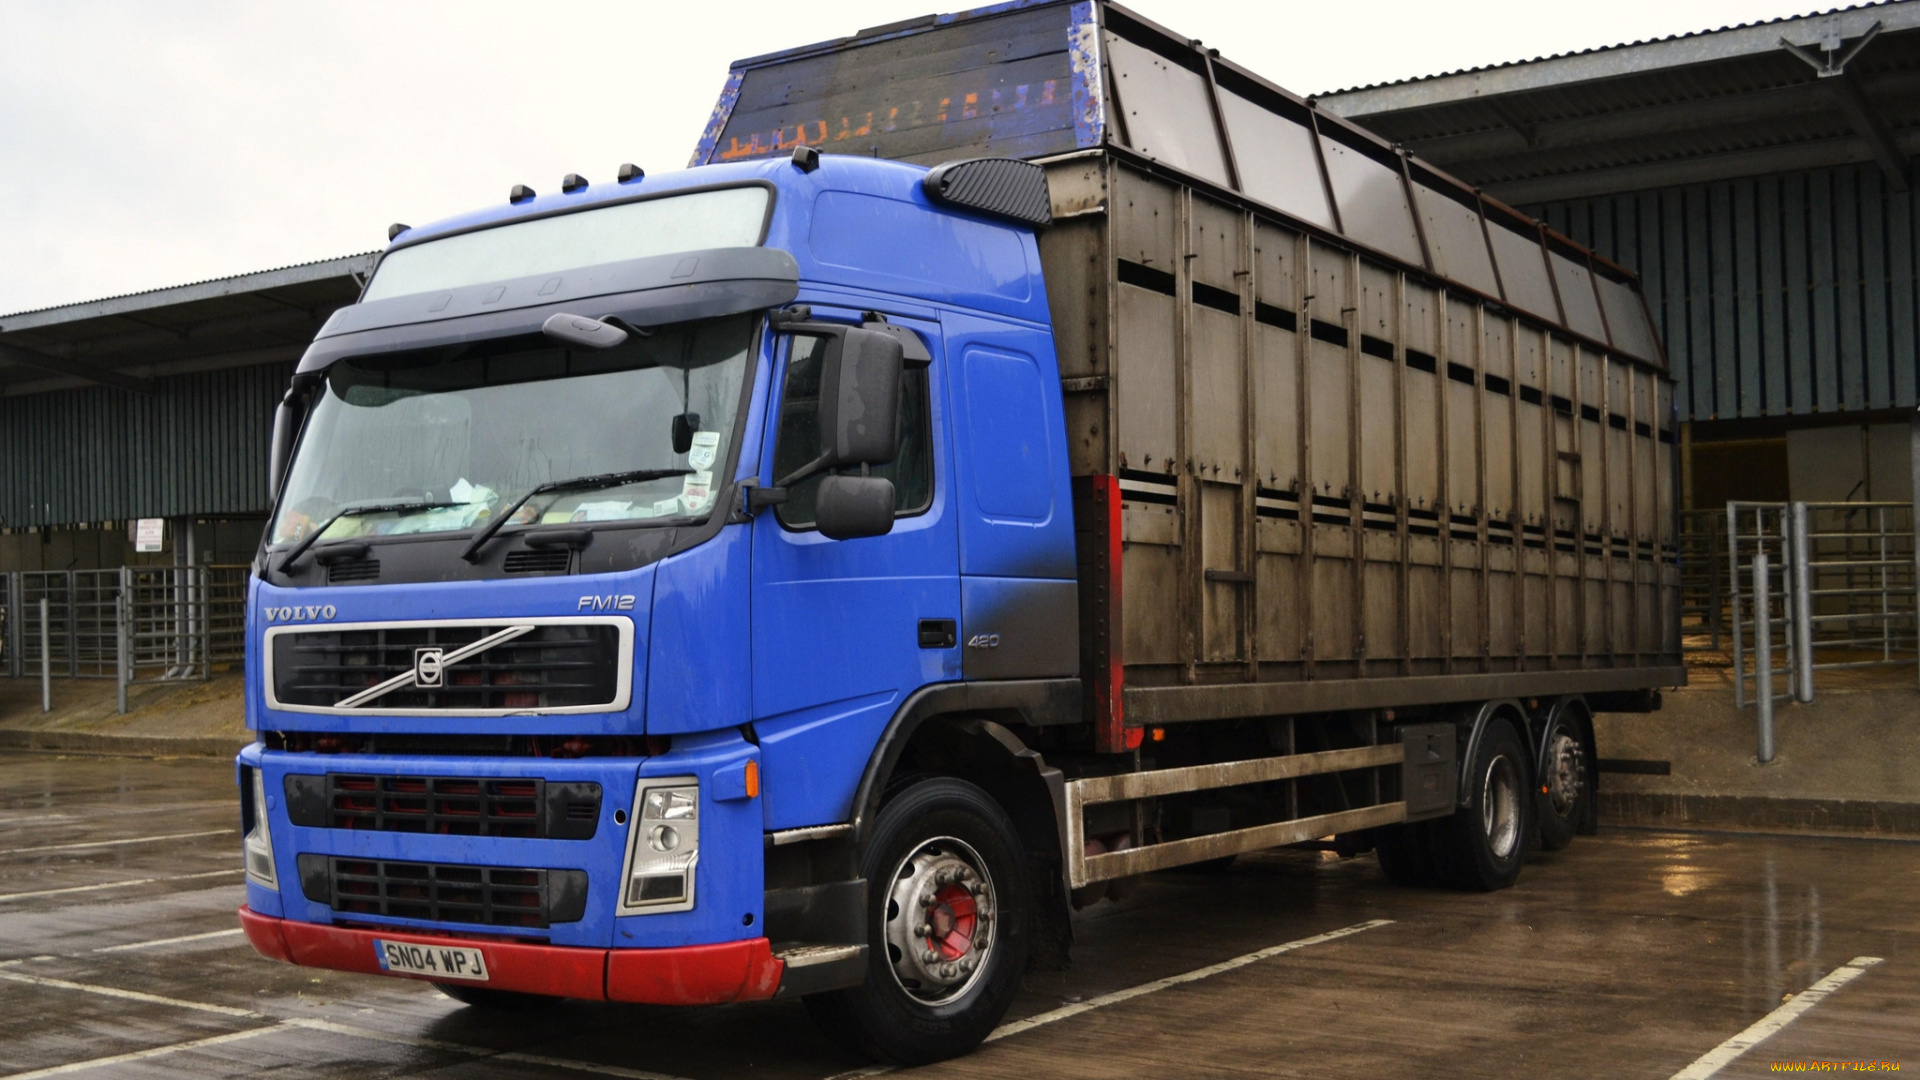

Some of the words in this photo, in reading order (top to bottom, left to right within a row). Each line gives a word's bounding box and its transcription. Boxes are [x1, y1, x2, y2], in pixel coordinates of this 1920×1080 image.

[577, 594, 636, 611] FM12
[263, 604, 337, 622] VOLVO
[968, 634, 1000, 648] 420
[386, 944, 437, 971] SN04
